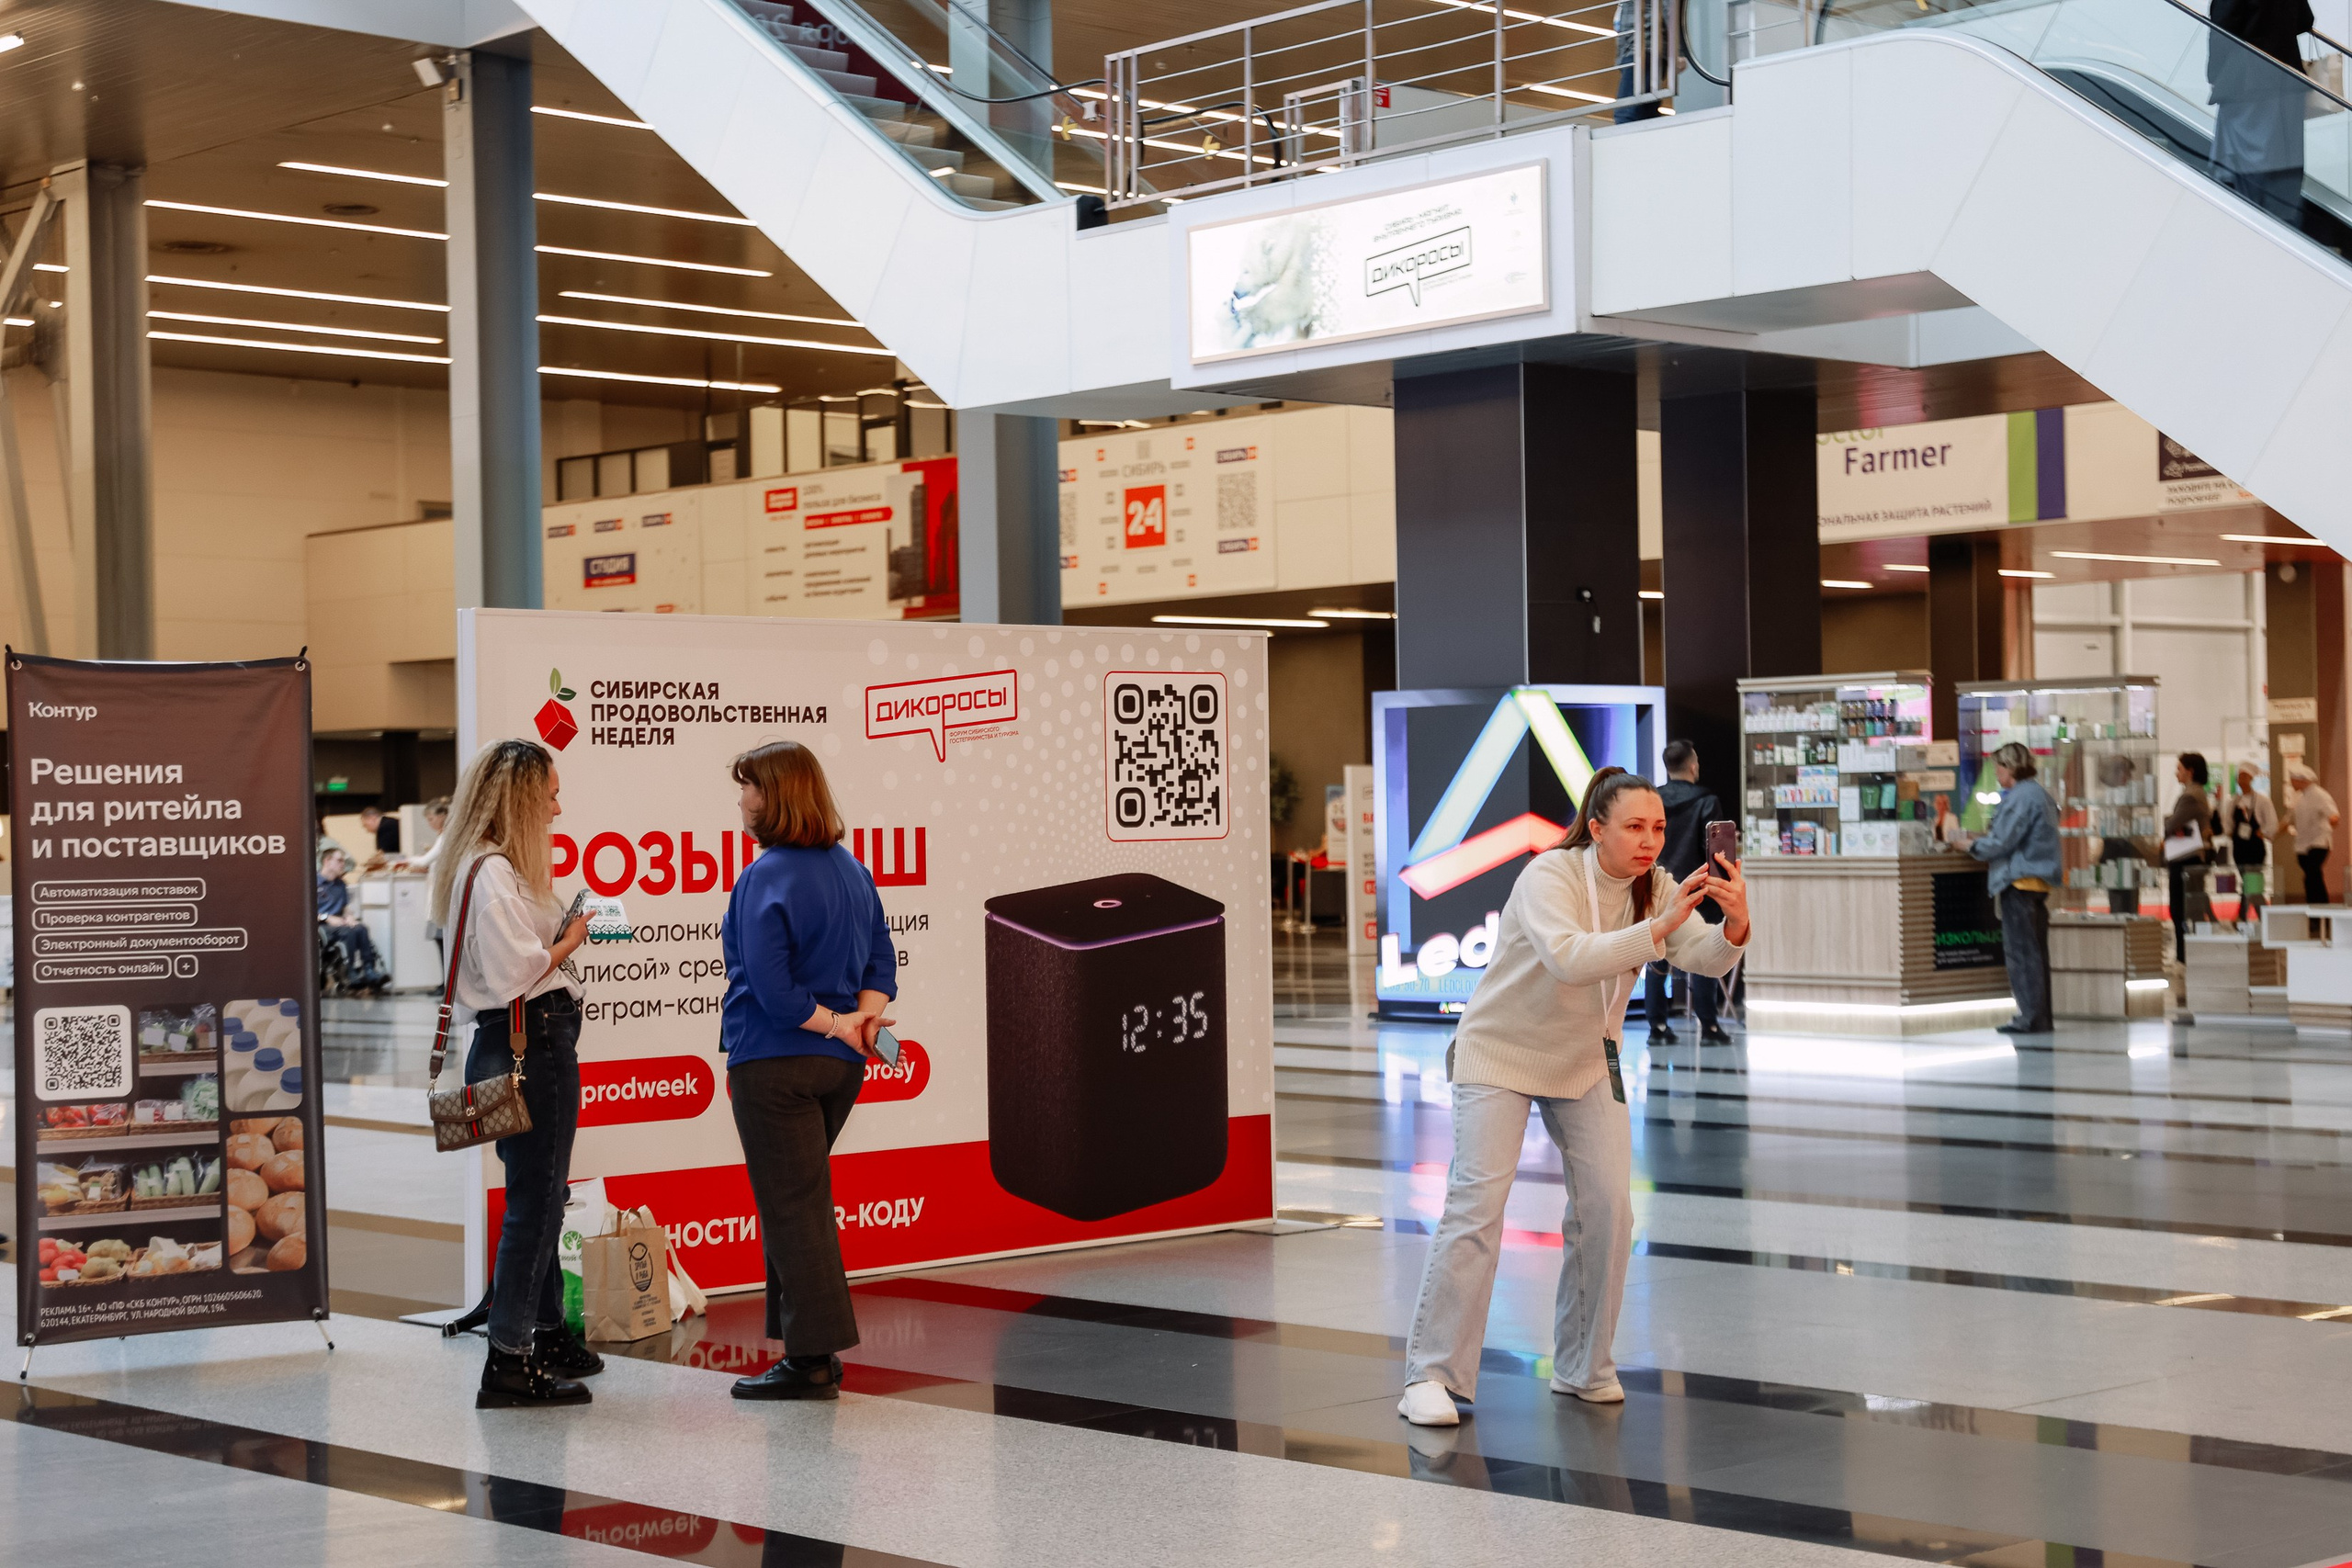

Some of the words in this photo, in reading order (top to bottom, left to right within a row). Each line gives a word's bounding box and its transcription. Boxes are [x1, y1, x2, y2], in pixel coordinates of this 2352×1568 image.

[1845, 443, 1952, 476] Farmer
[1127, 497, 1163, 536] 24
[1883, 508, 1929, 523] ЗАЩИТА
[1933, 500, 1993, 516] РАСТЕНИЙ
[590, 680, 719, 700] СИБИРСКАЯ
[28, 702, 98, 721] Контур
[591, 704, 828, 725] ПРОДОВОЛЬСТВЕННАЯ
[876, 686, 1007, 723] ДИКОРОСЫ
[591, 727, 675, 749] НЕДЕЛЯ
[949, 733, 993, 744] ГОСТЕПРИИМСТВА
[968, 726, 1001, 735] СИБИРСКОГО
[30, 758, 183, 785] Решения
[30, 801, 95, 826] для
[103, 794, 243, 827] ритейла
[31, 839, 52, 859] и
[62, 833, 287, 860] поставщиков
[40, 886, 139, 898] Автоматизация
[141, 886, 198, 897] поставок
[40, 913, 104, 926] Проверка
[106, 910, 190, 923] контрагентов
[40, 936, 128, 952] Электронный
[130, 933, 241, 949] документооборот
[41, 964, 117, 977] Отчетность
[118, 962, 164, 974] онлайн
[679, 958, 729, 984] сре
[577, 995, 724, 1026] еграм-кан
[1122, 991, 1208, 1054] 12:35
[581, 1072, 698, 1110] prodweek
[40, 1305, 76, 1316] РЕКЛАМА
[96, 1303, 107, 1312] АО
[126, 1299, 144, 1309] «СКБ
[183, 1295, 201, 1303] ОГРН
[41, 1318, 71, 1327] 620144,
[72, 1312, 129, 1325] ЕКАТЕРИНБУРГ,
[130, 1310, 142, 1320] УЛ.
[143, 1305, 186, 1318] НАРОДНОЙ
[187, 1303, 210, 1314] ВОЛИ,
